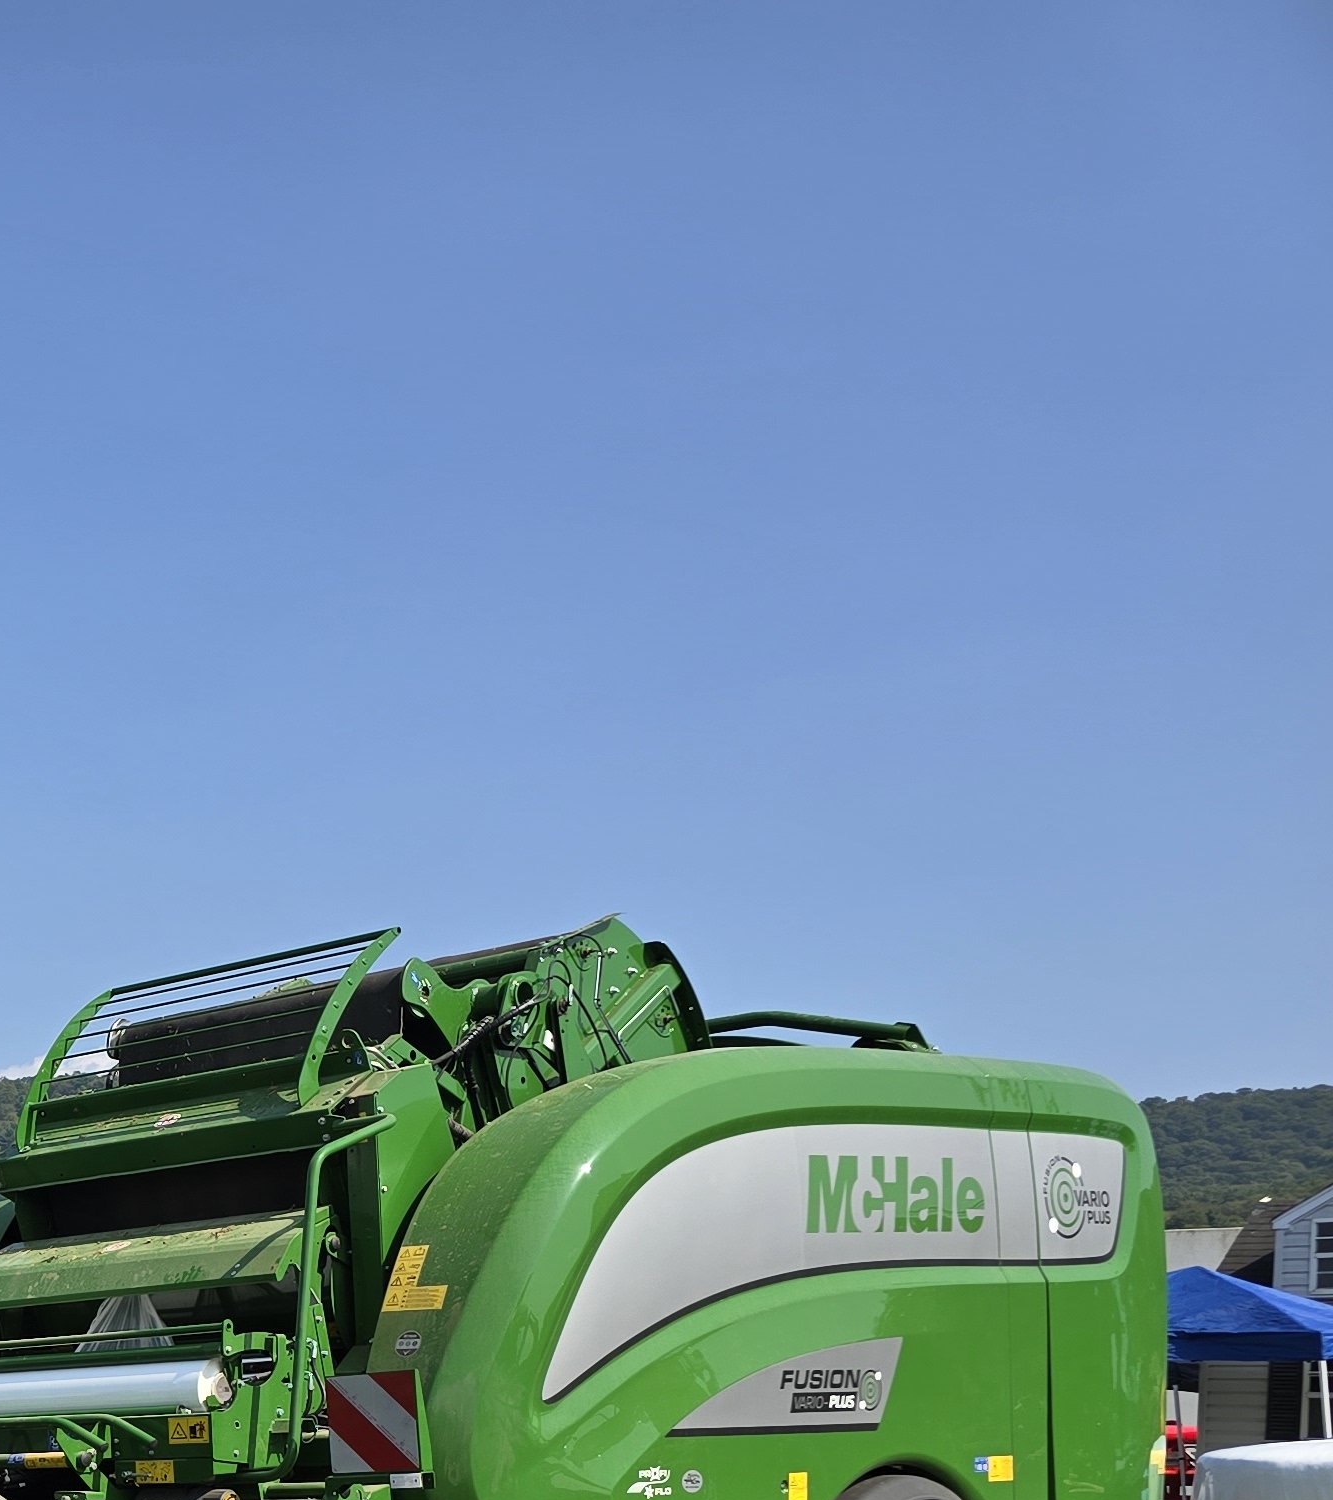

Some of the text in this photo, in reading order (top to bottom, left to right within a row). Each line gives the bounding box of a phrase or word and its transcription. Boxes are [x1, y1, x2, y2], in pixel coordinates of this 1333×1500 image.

[806, 1154, 985, 1233] McHale
[1072, 1189, 1110, 1207] VARIO
[1087, 1210, 1111, 1225] PLUS
[779, 1369, 861, 1390] FUSION
